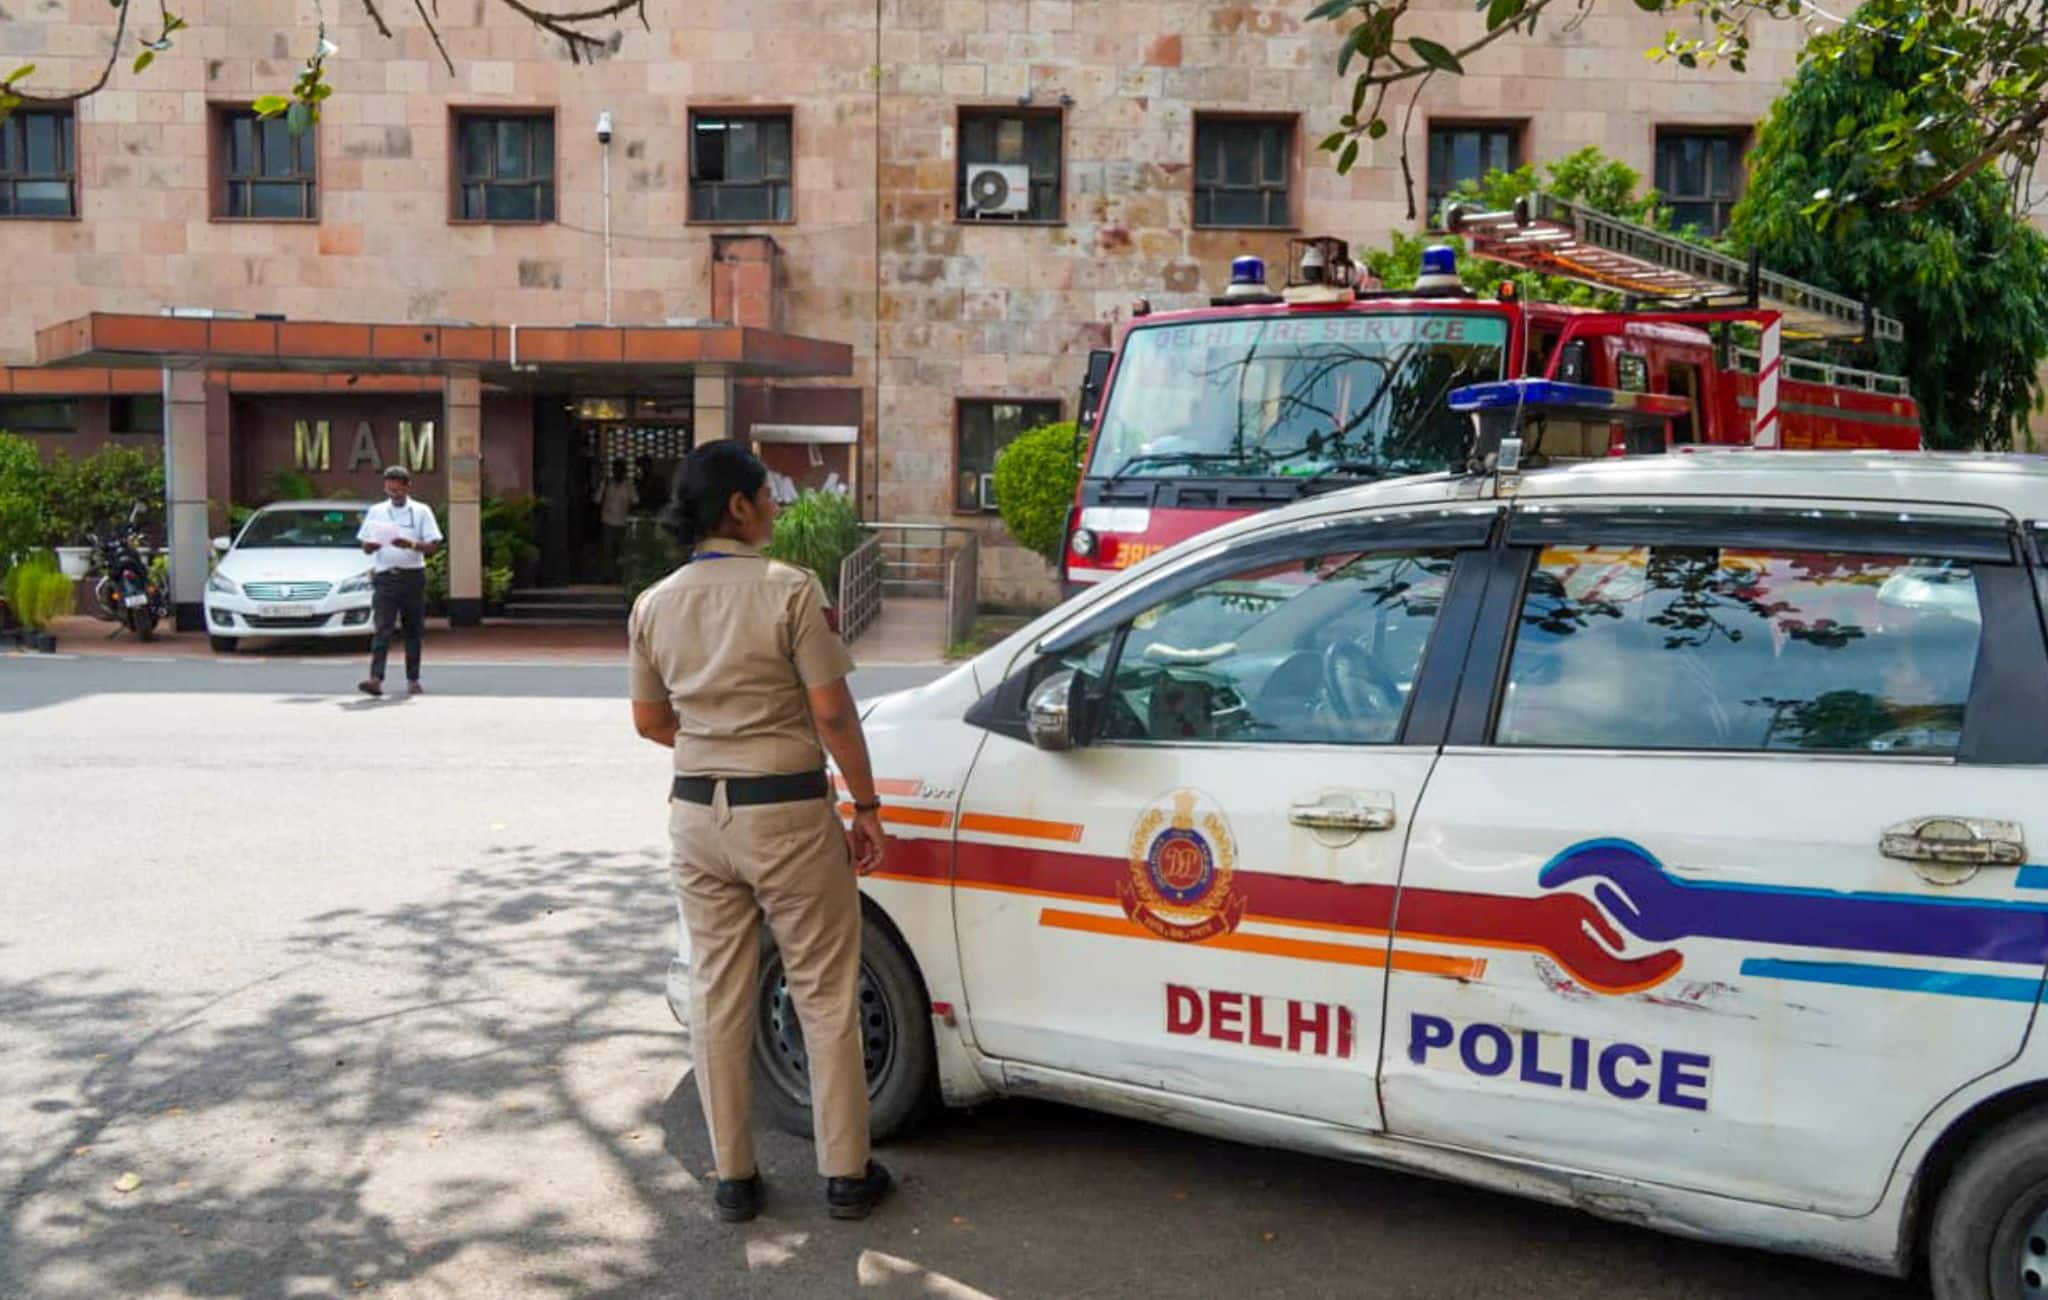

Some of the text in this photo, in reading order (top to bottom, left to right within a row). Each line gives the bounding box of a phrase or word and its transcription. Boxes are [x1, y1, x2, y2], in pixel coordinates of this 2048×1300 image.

[1154, 318, 1466, 348] DELHI FIRE SERVICE
[1166, 984, 1710, 1112] DELHI POLICE
